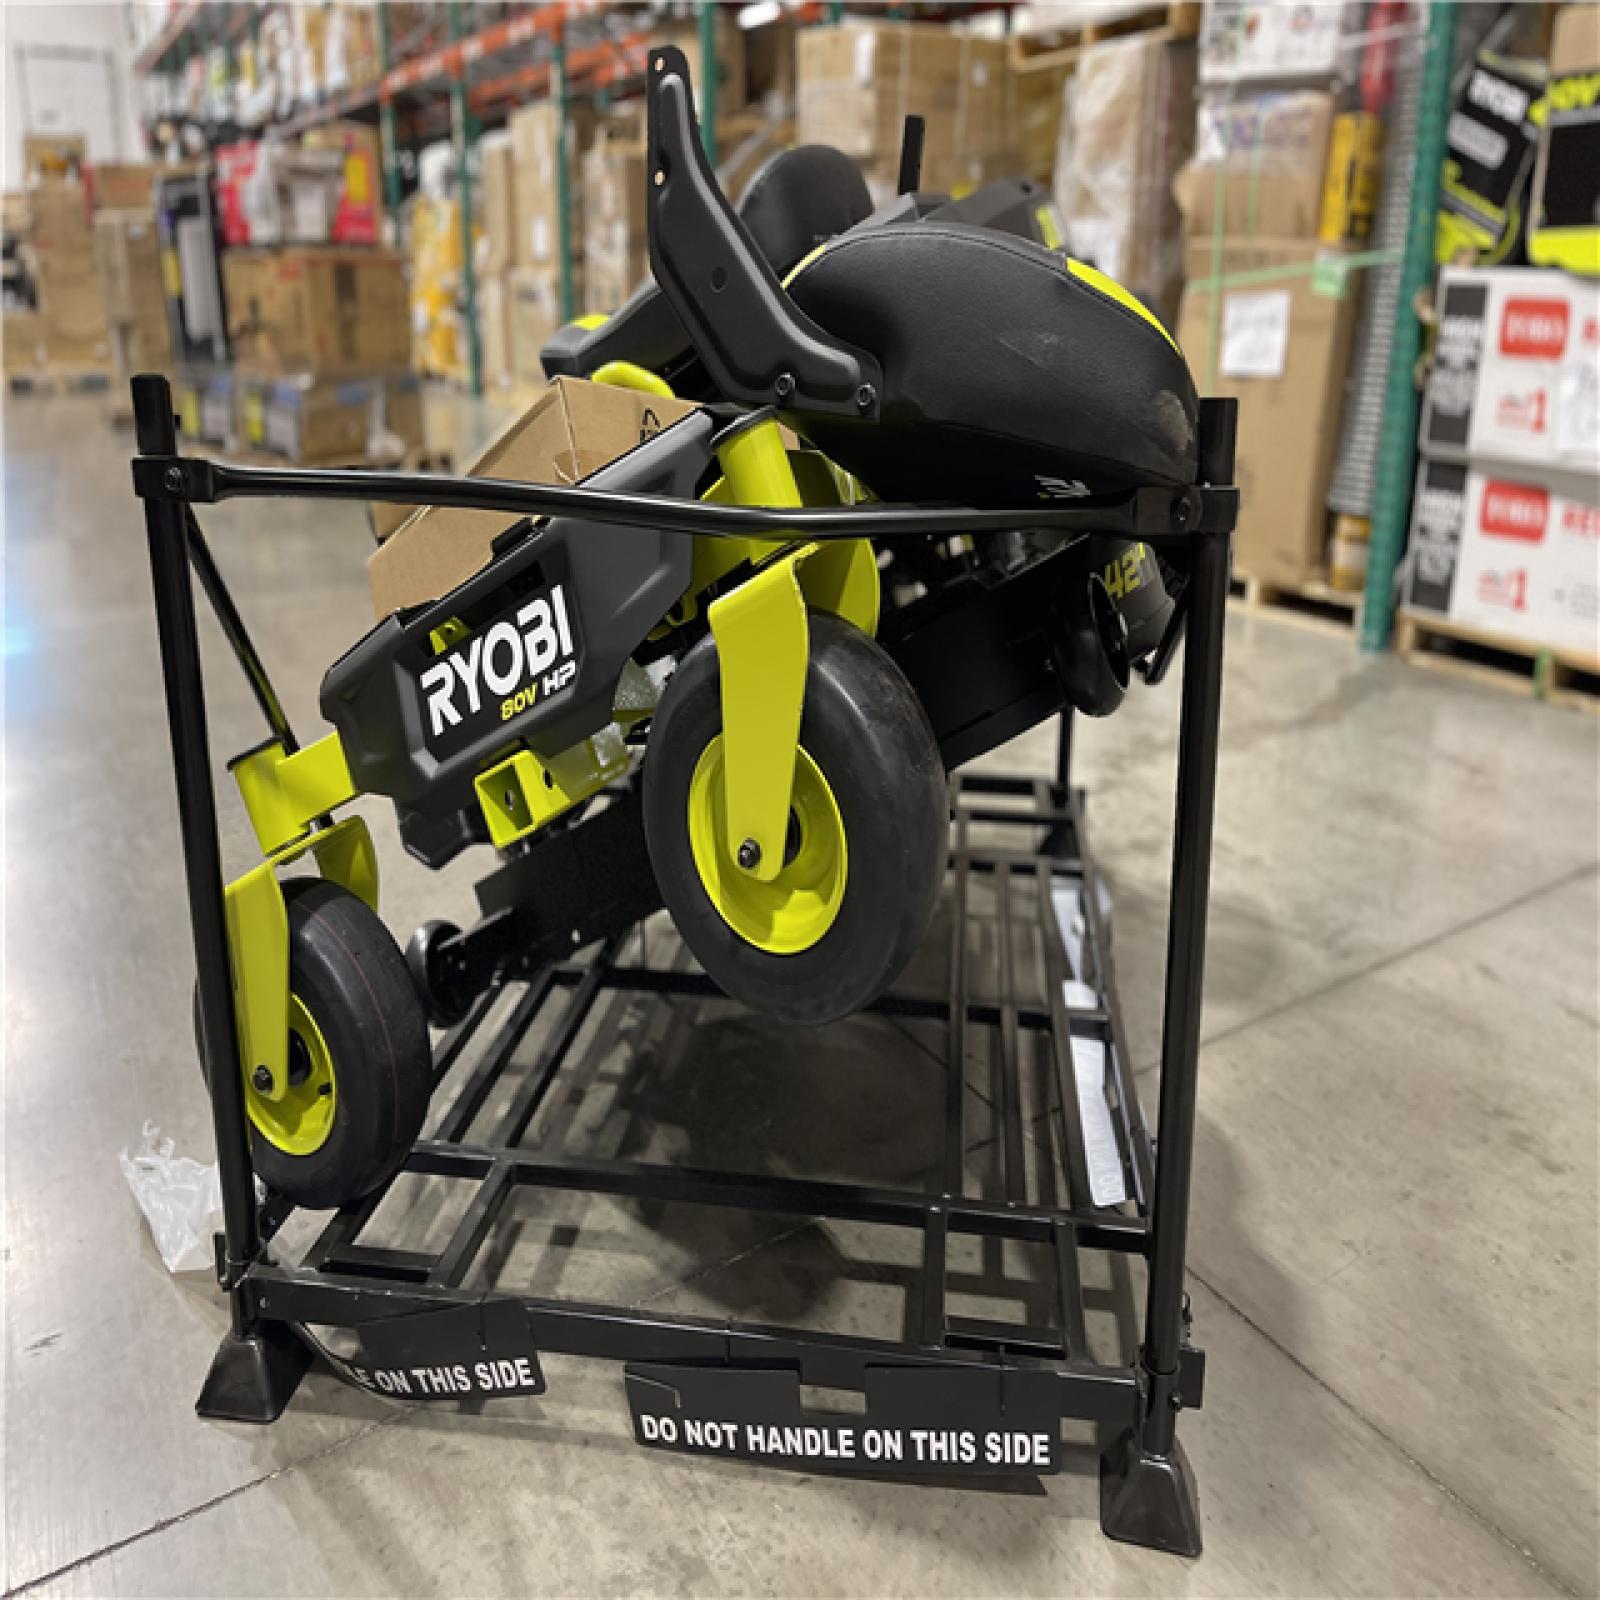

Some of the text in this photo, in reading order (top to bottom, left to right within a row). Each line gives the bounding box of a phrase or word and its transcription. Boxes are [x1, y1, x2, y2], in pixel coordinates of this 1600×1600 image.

[420, 585, 573, 736] RYOBI
[501, 660, 576, 720] 80V HP
[375, 1370, 411, 1393] ON
[411, 1366, 471, 1393] THIS
[475, 1358, 536, 1391] SIDE
[640, 1415, 1051, 1465] DO NOT HANDLE ON THIS SIDE
